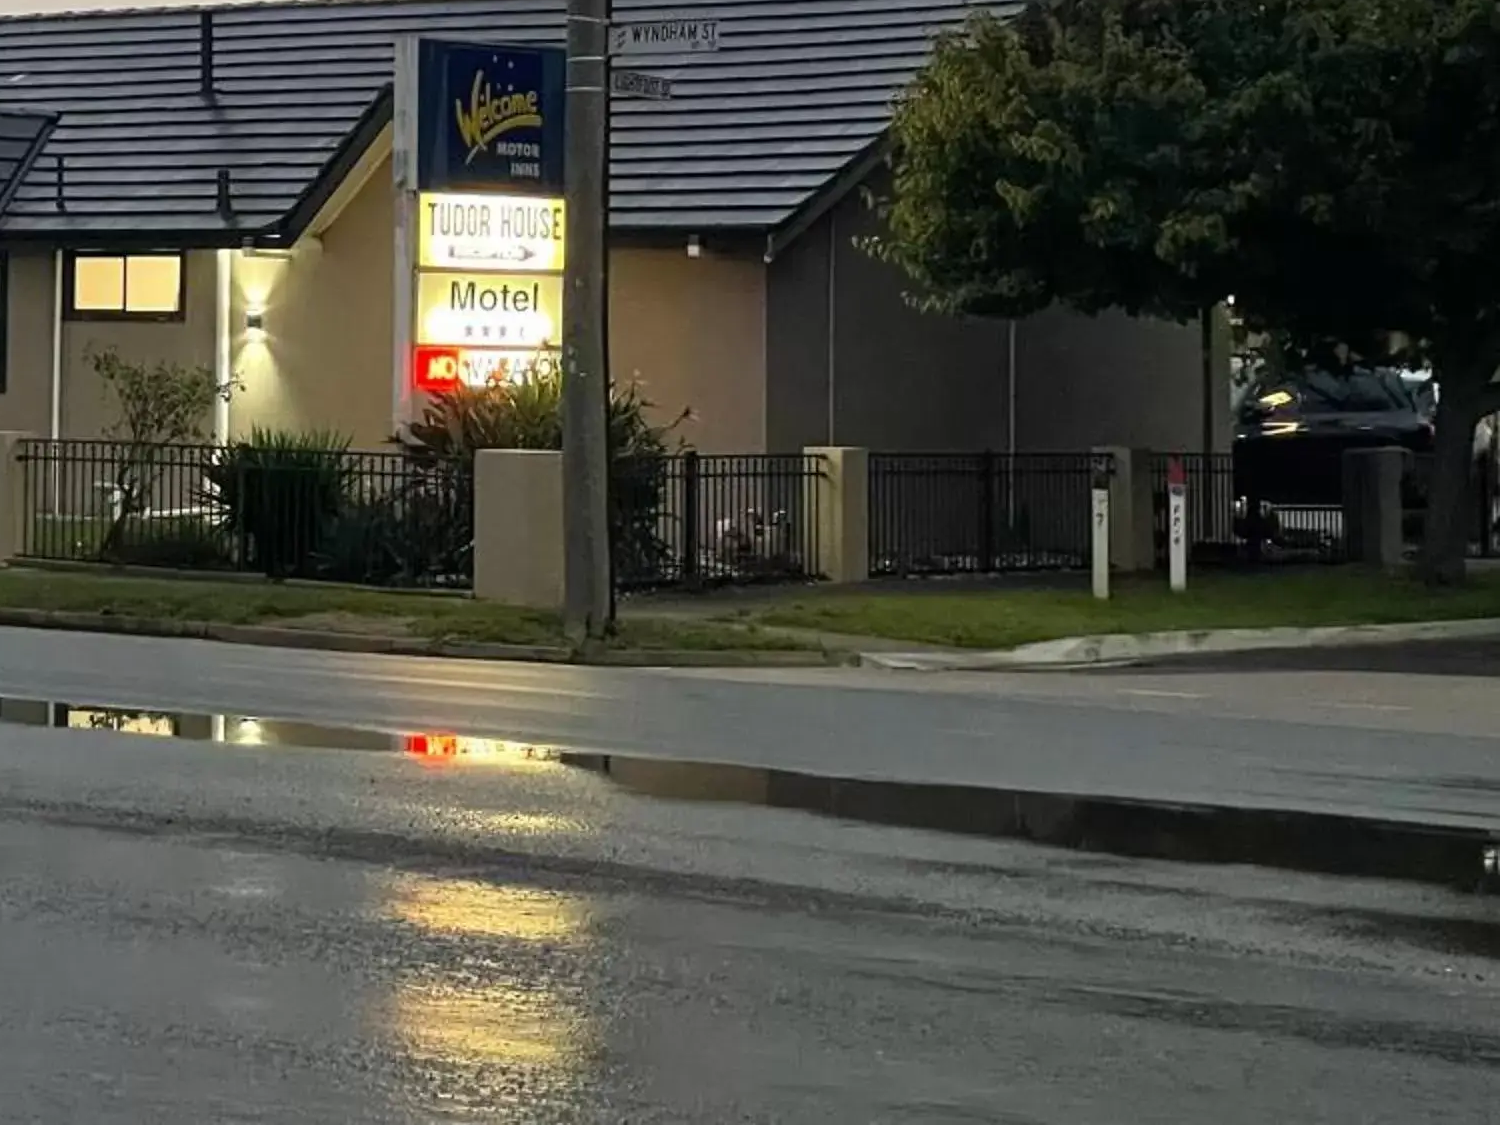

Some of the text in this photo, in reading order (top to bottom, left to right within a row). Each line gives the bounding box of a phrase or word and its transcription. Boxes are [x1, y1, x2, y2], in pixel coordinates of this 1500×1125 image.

[631, 22, 698, 44] WYNDHAM
[701, 22, 717, 41] ST
[455, 69, 538, 152] Welcome
[496, 141, 541, 157] MOTOR
[427, 202, 563, 241] TUDOR HOUSE
[450, 280, 539, 313] Motel
[426, 355, 457, 381] NO
